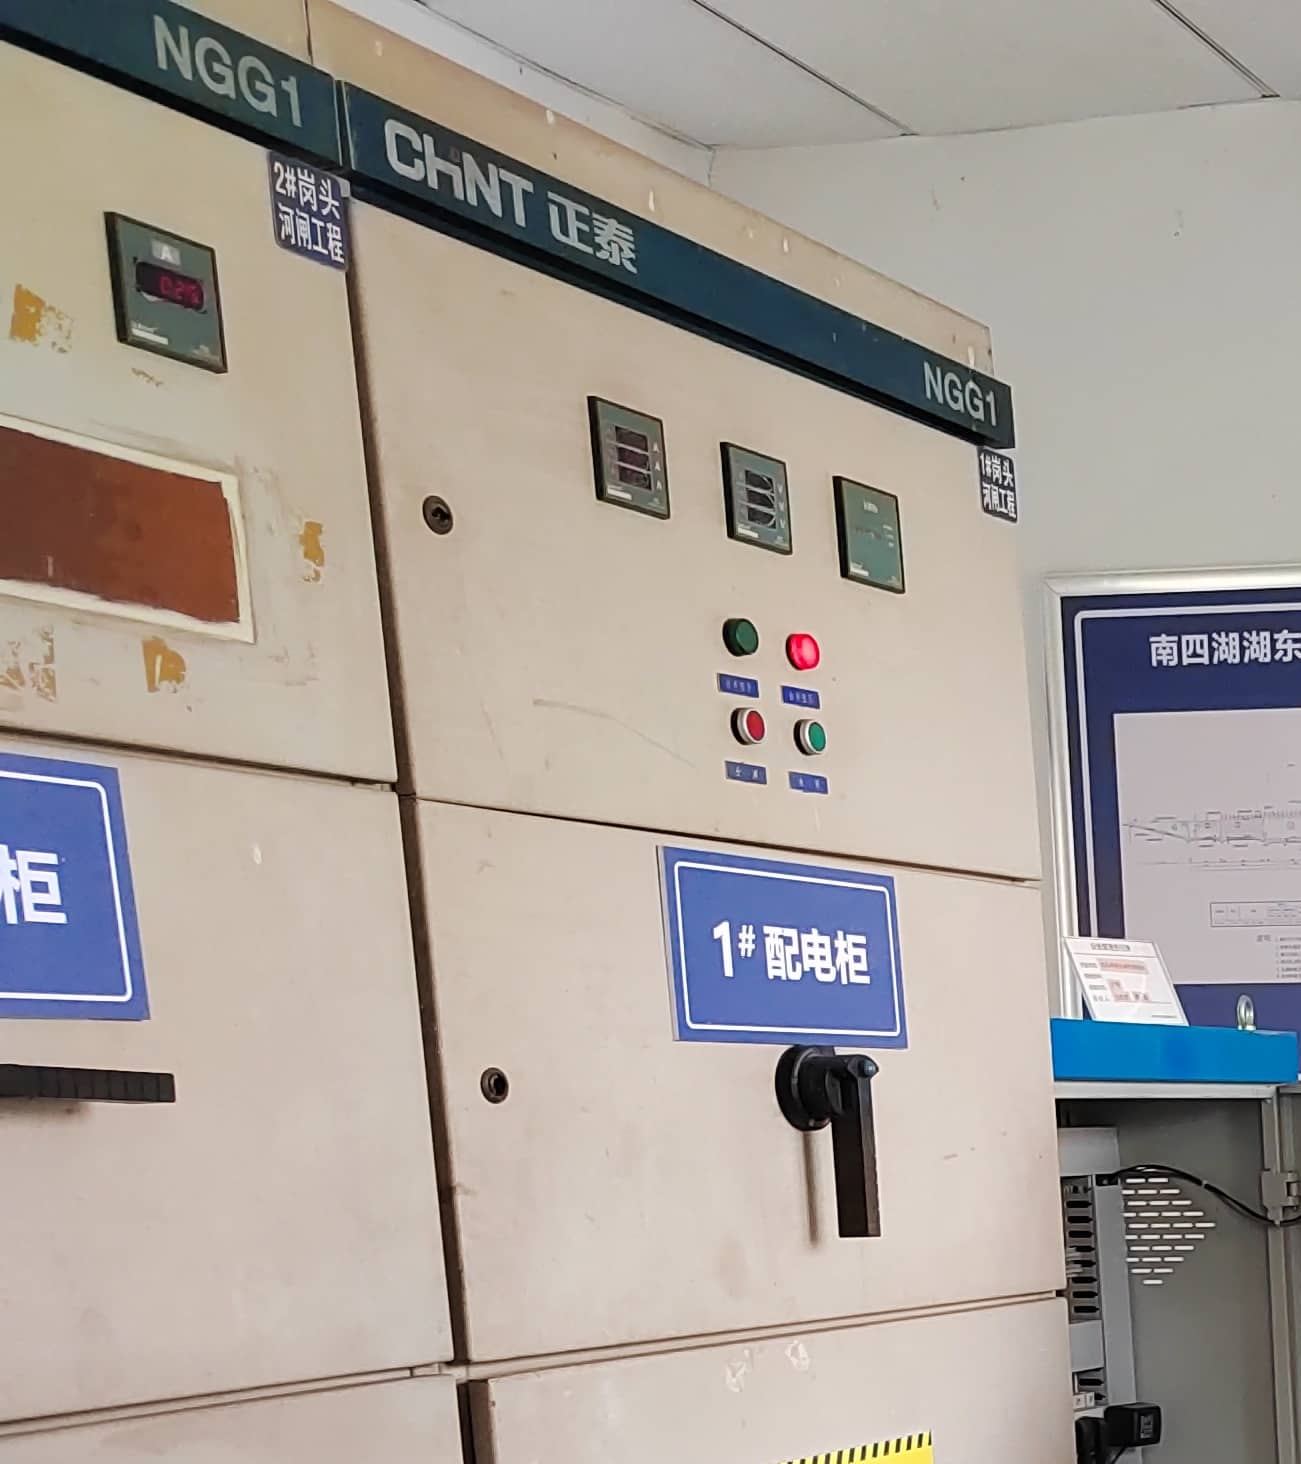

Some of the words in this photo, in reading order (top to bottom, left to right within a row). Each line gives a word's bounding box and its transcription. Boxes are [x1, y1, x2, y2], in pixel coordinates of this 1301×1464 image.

[153, 15, 302, 128] NGG1
[274, 161, 341, 220] 2#岗头
[277, 202, 344, 263] 河闸工程
[546, 190, 638, 275] 正泰
[923, 361, 997, 426] NGG1
